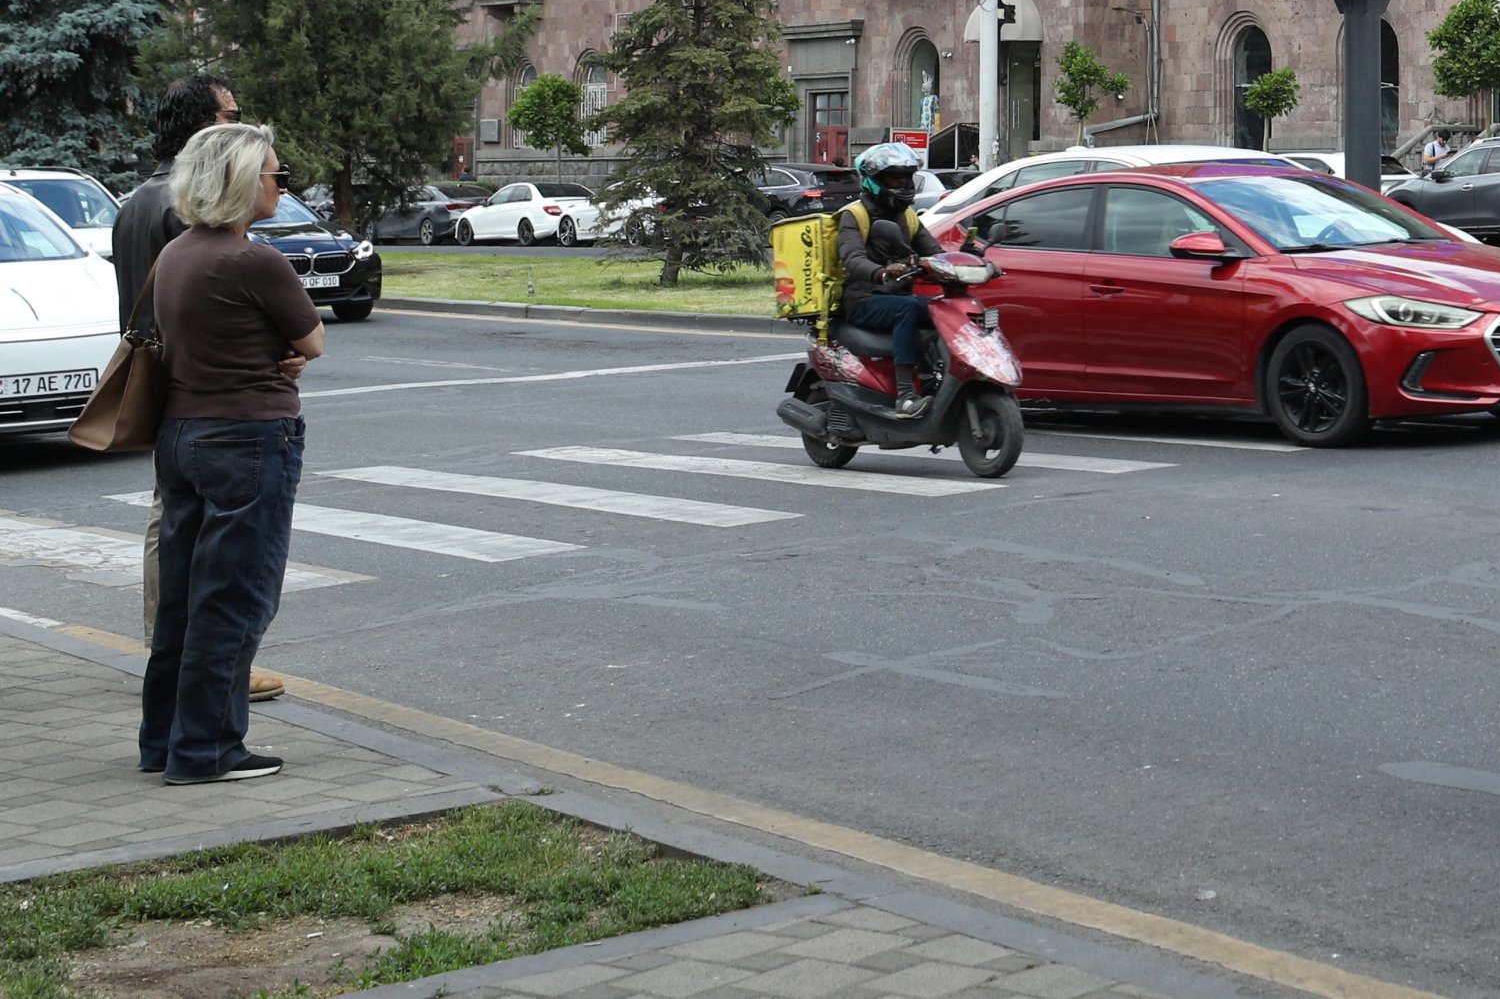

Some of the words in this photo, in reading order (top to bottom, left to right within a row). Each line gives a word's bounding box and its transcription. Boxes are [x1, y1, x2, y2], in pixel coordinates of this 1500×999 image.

[801, 225, 813, 248] Go
[802, 251, 812, 305] Yandex
[12, 378, 31, 394] 17
[37, 375, 58, 392] AE
[64, 372, 92, 390] 770
